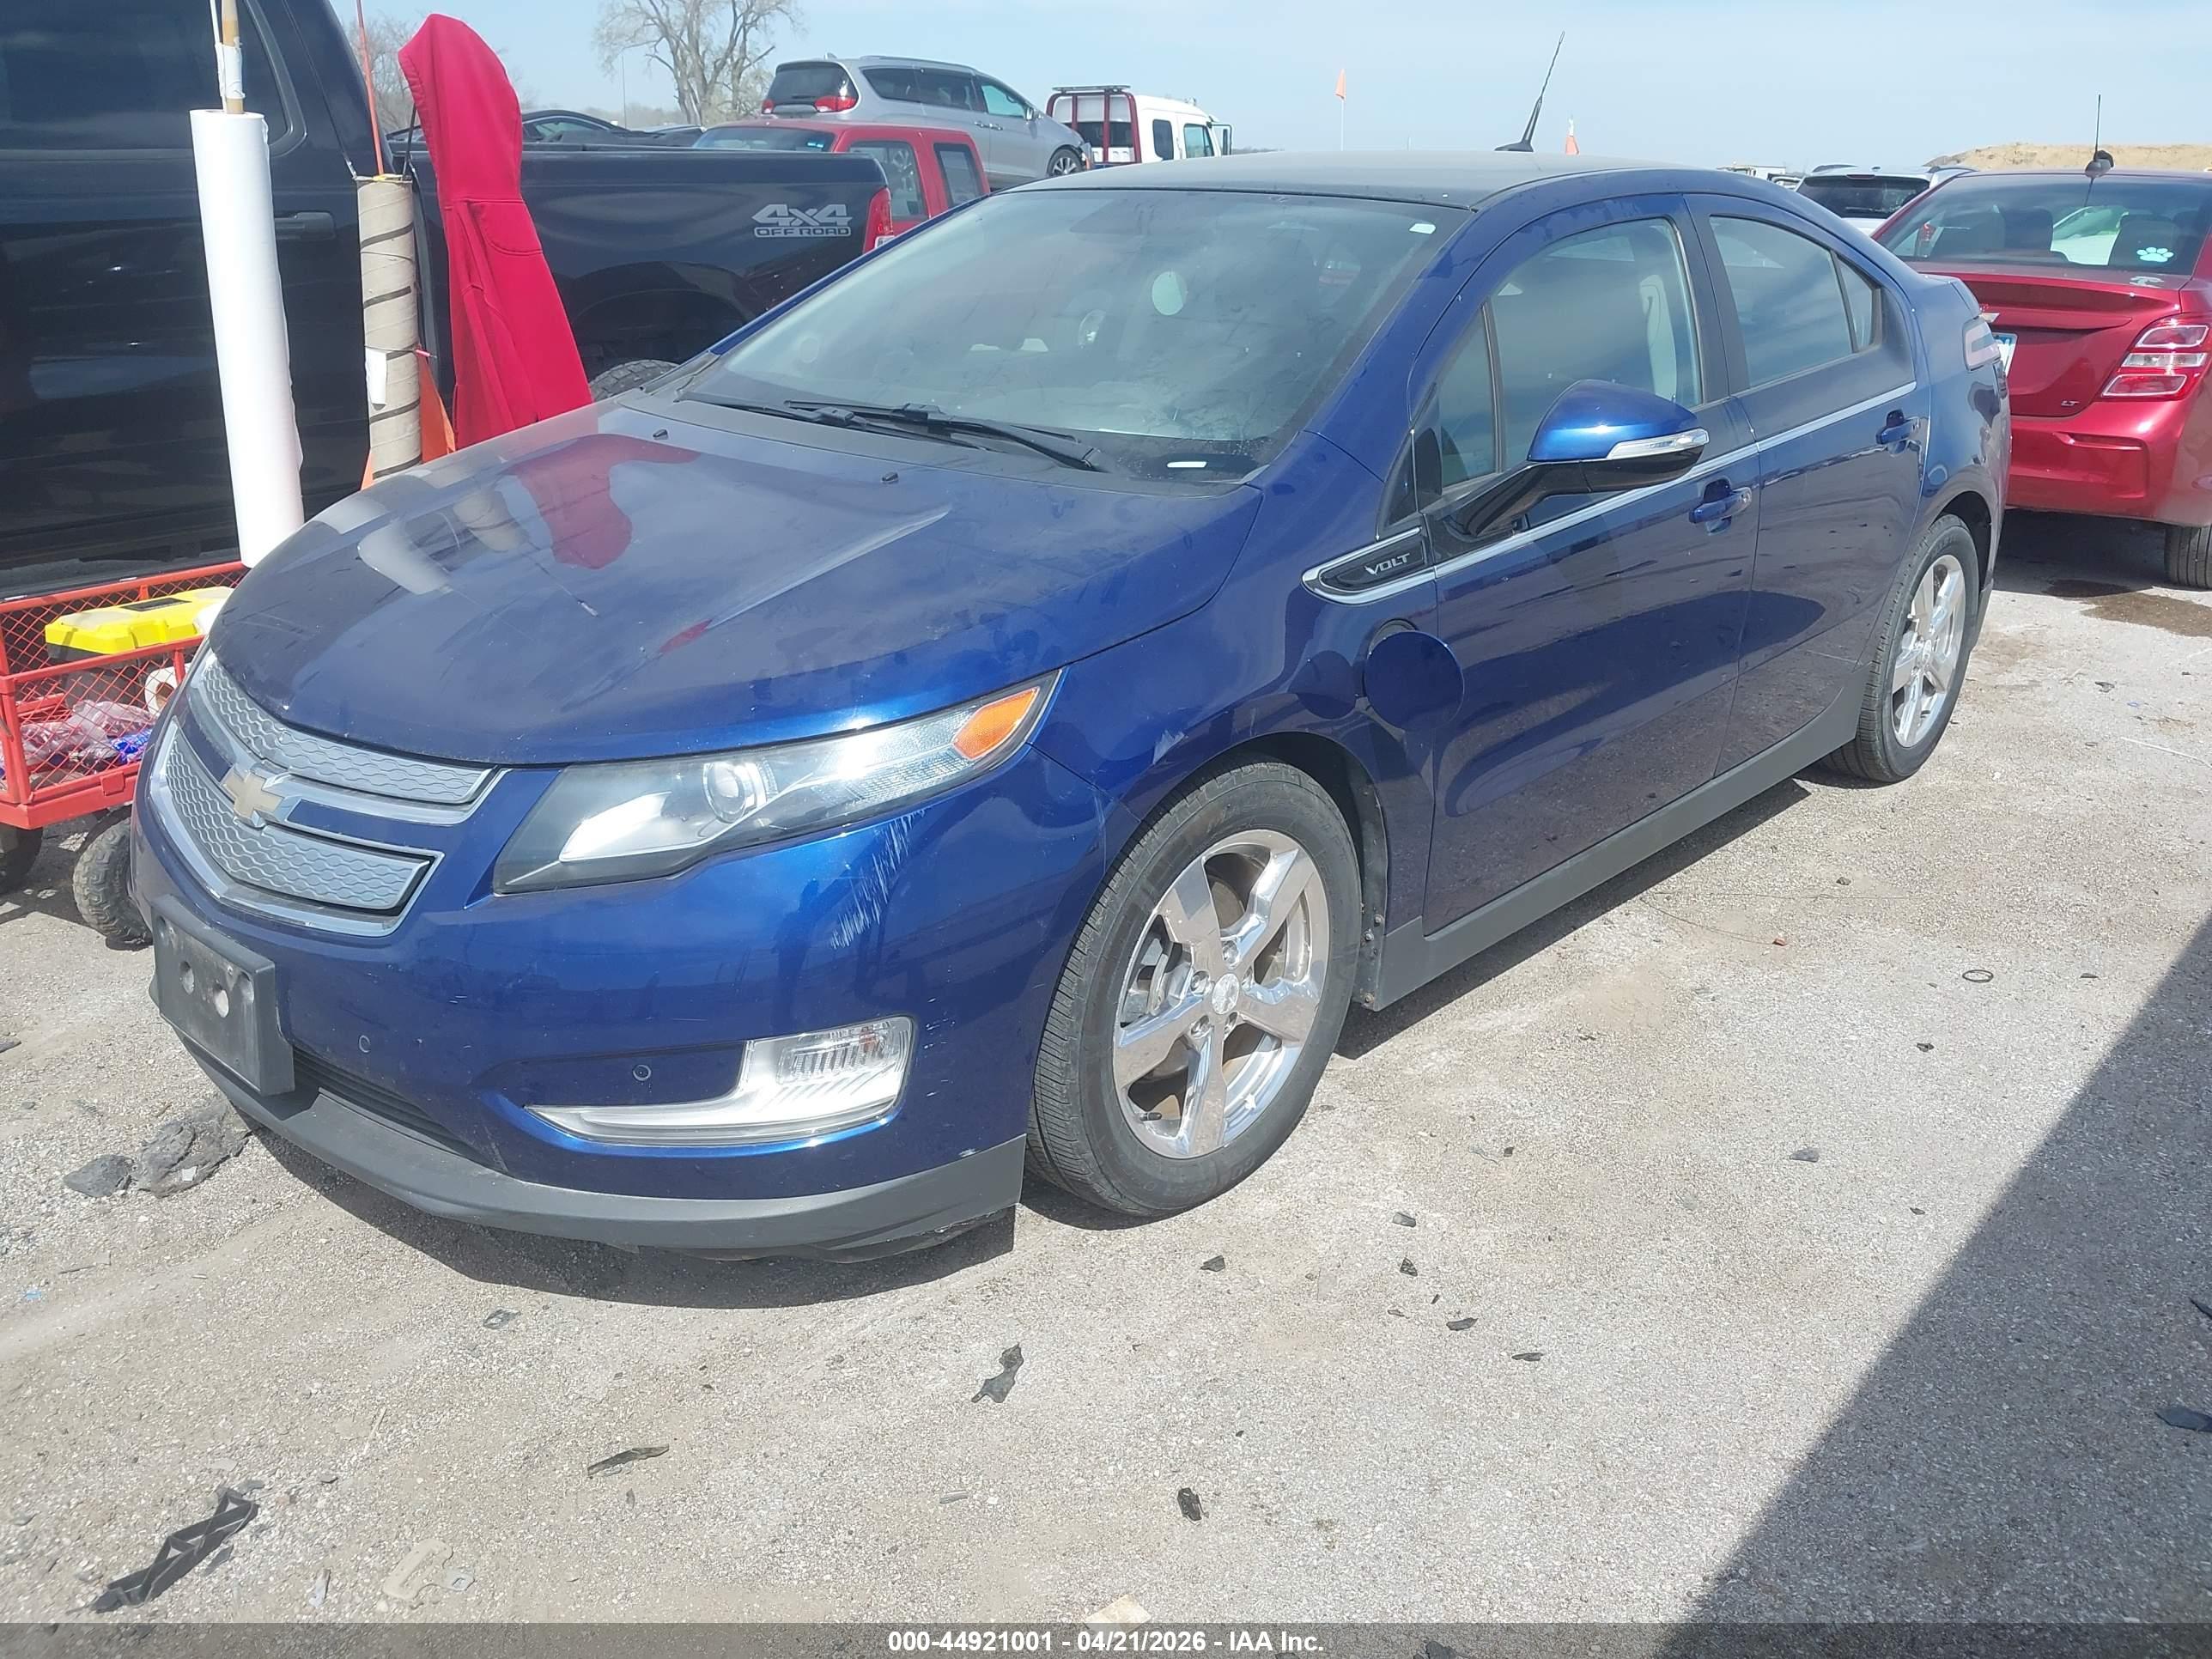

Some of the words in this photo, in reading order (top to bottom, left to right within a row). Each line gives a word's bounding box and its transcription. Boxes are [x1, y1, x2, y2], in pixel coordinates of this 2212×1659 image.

[757, 228, 794, 236] OFF
[799, 228, 849, 236] ROAD
[1364, 553, 1410, 575] VOLT
